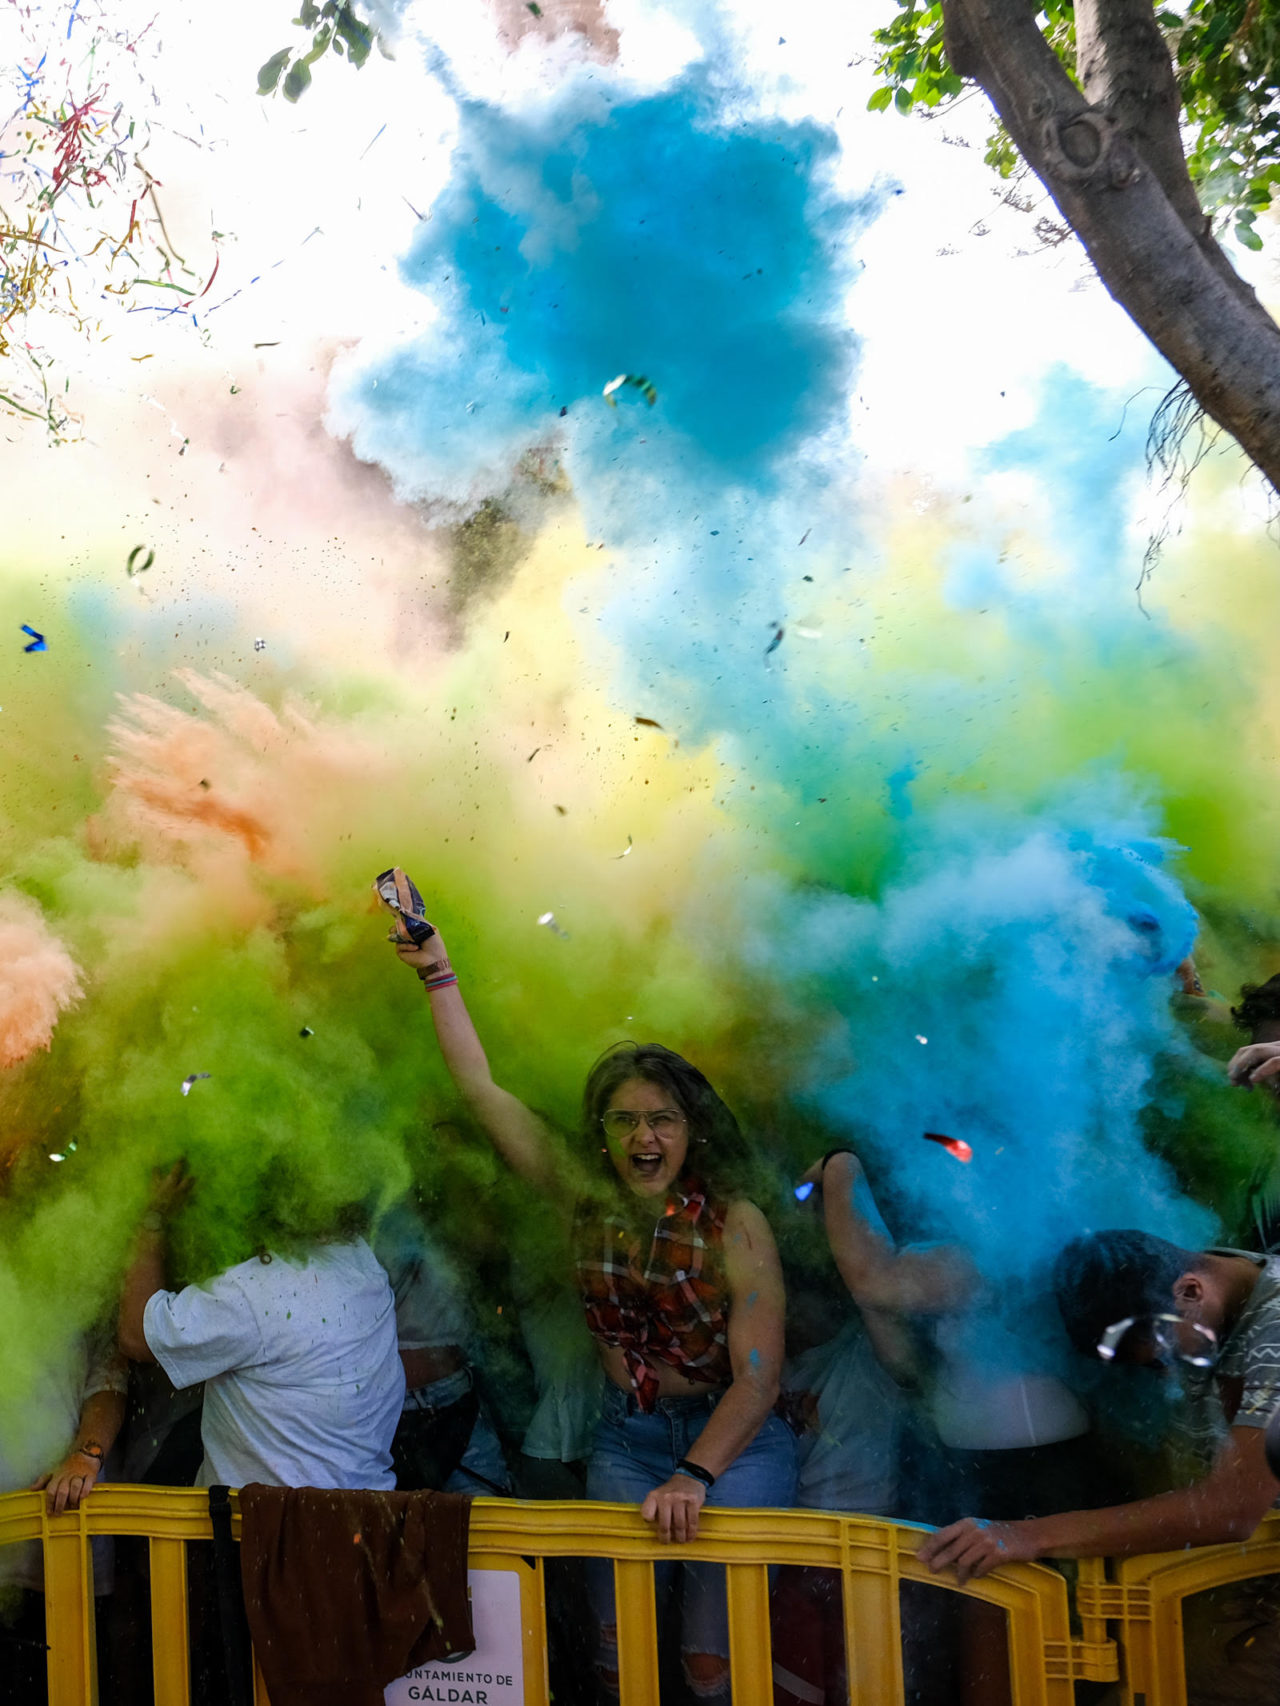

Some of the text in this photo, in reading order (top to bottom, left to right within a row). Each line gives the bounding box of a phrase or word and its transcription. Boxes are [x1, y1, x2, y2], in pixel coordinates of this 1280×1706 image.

[405, 1669, 513, 1686] UNTAMIENTO DE
[408, 1685, 488, 1705] GÁLDAR
